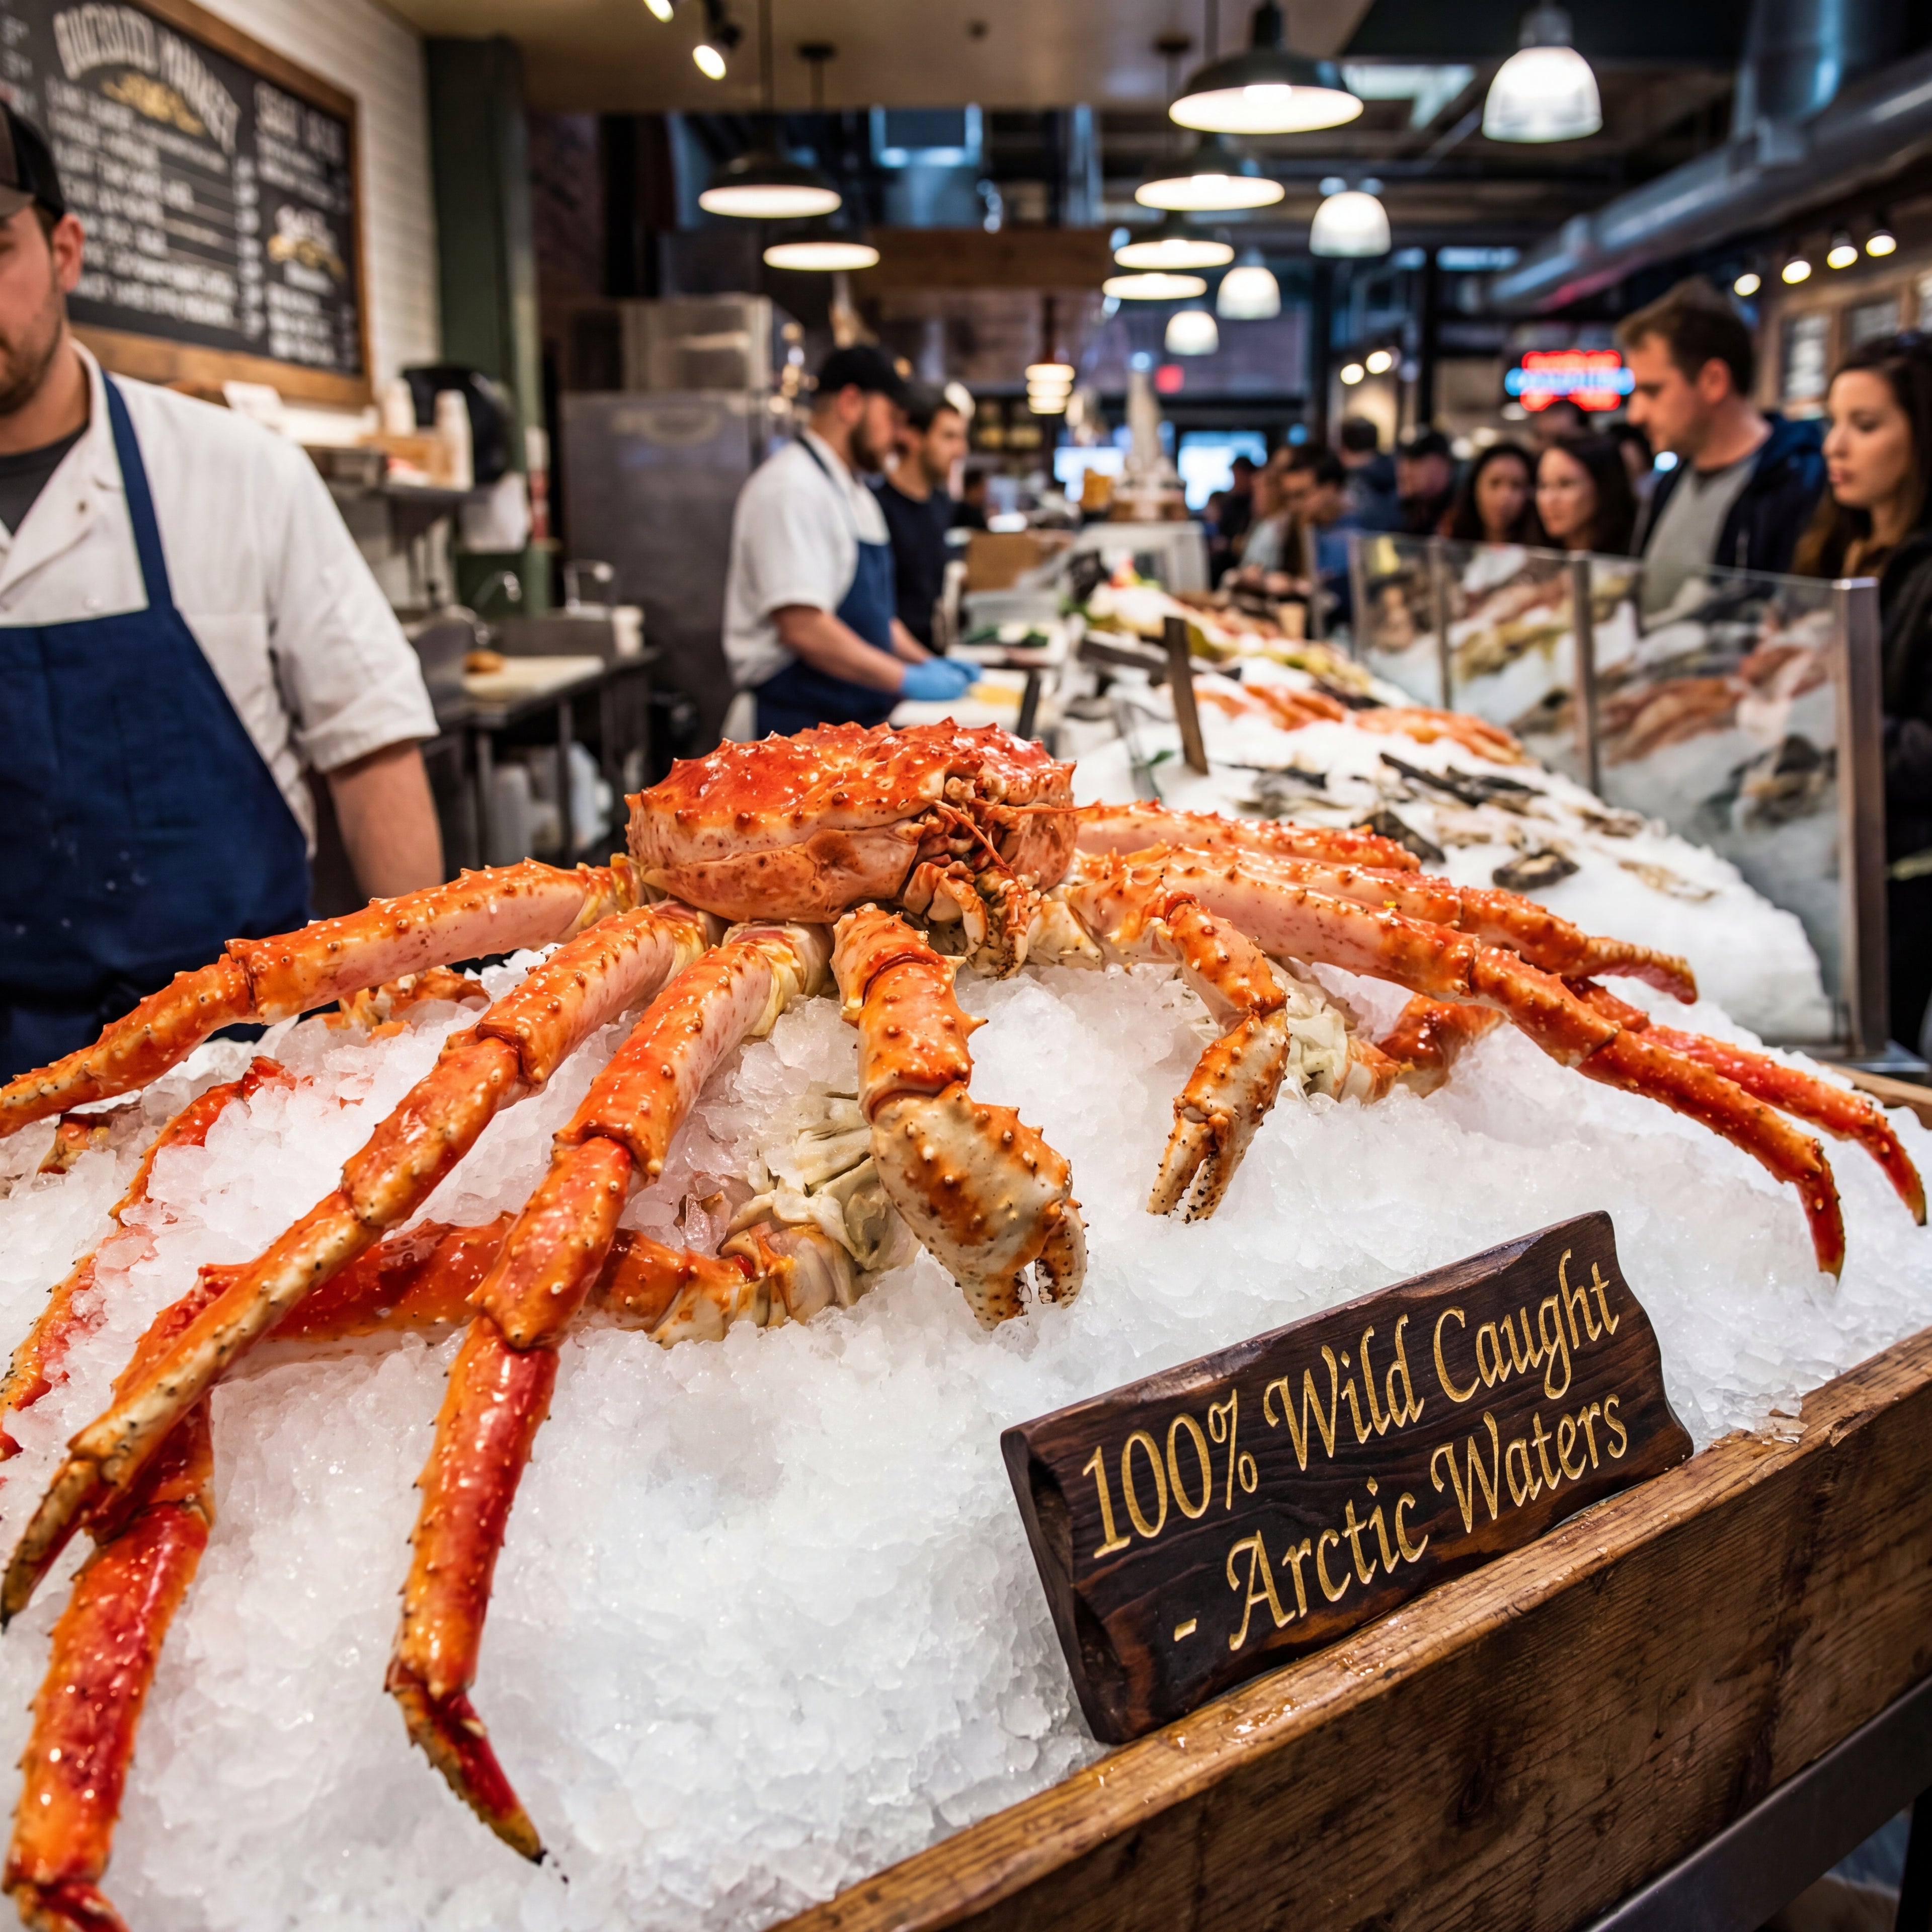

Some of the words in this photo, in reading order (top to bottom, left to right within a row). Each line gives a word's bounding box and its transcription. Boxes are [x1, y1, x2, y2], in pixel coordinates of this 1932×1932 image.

[1083, 1389, 1258, 1559] 100%
[1263, 1314, 1425, 1471] Wild
[1434, 1249, 1620, 1403] Caught
[1227, 1477, 1429, 1651] Arctic
[1430, 1394, 1628, 1534] Waters
